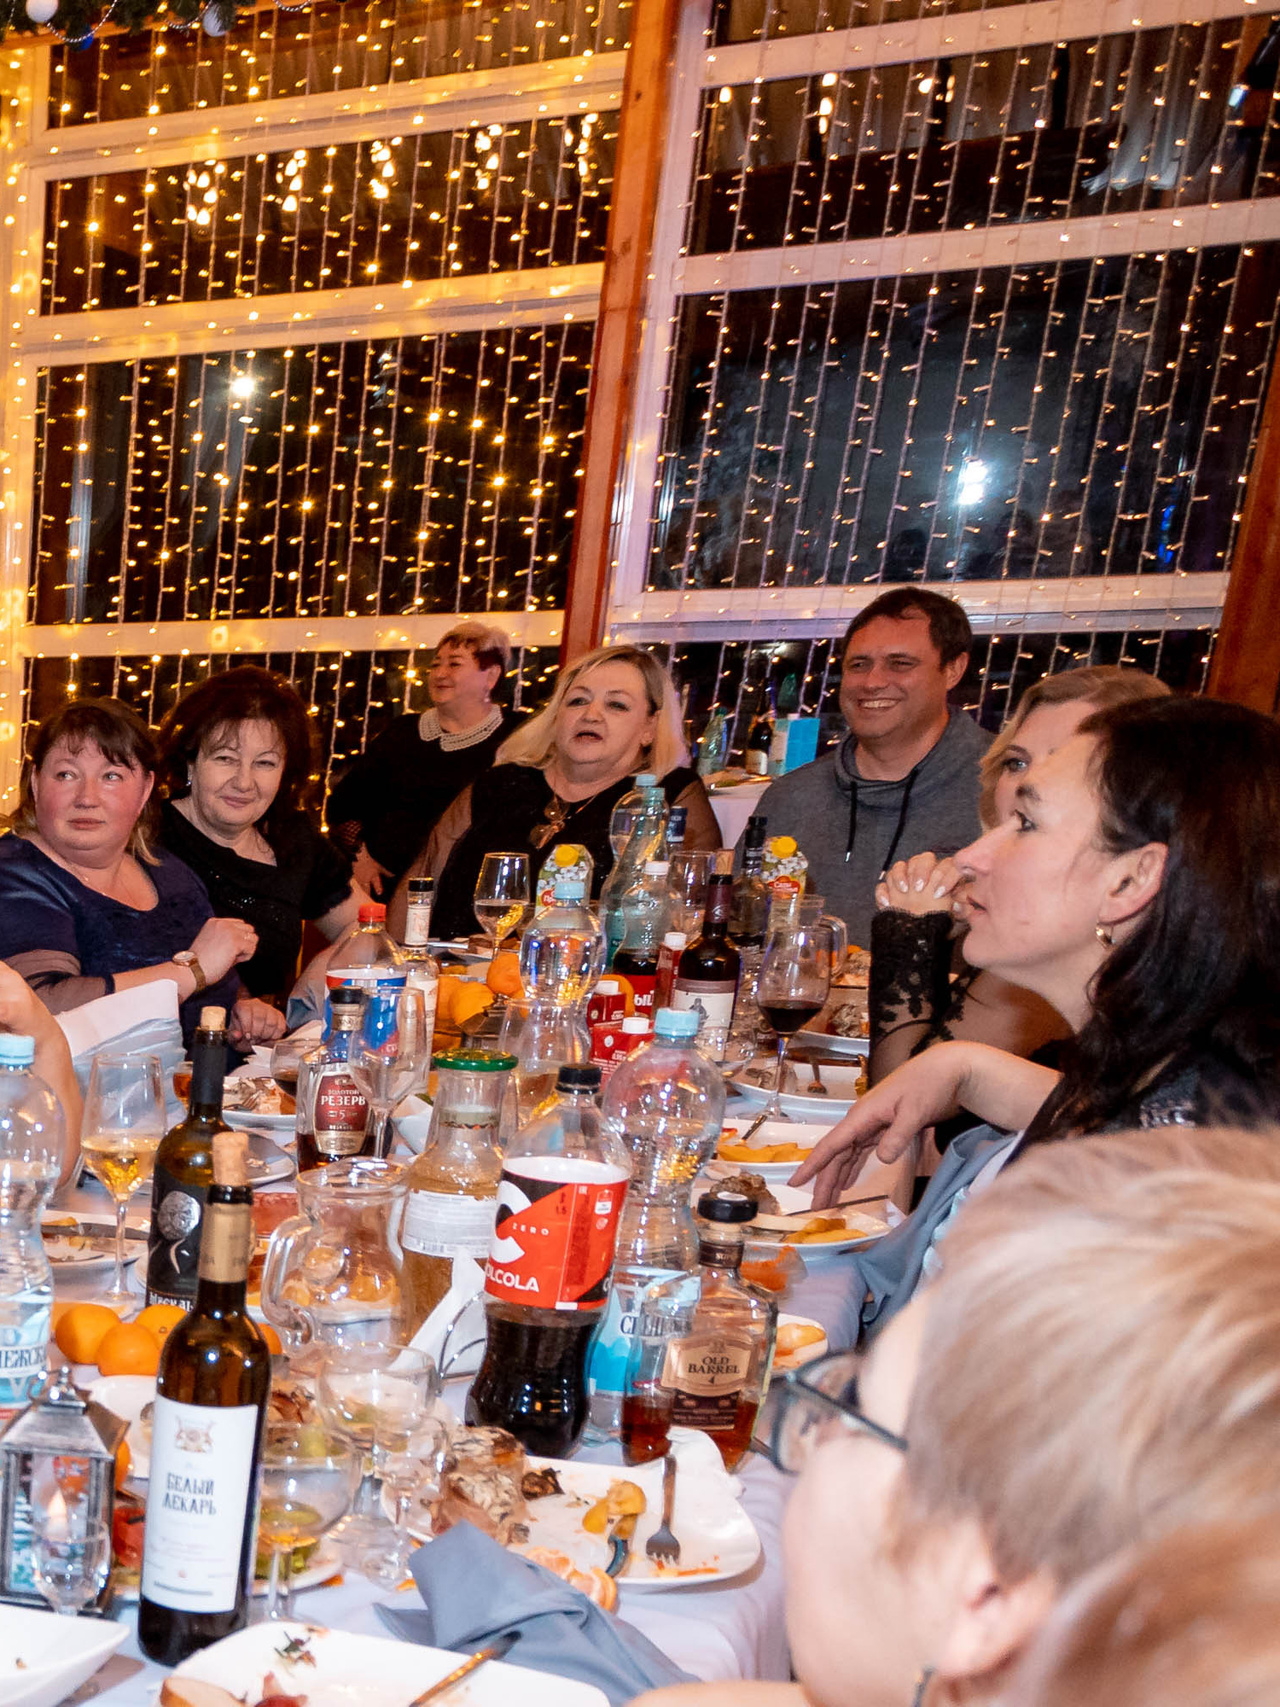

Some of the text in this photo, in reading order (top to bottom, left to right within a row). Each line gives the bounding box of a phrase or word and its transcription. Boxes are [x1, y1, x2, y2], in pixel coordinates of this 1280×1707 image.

[320, 1095, 366, 1107] РЕЗЕРВ
[512, 1222, 550, 1236] ZERO
[702, 1356, 730, 1365] OLD
[687, 1363, 740, 1374] BARREL
[166, 1472, 215, 1496] БЕЛЫЙ
[162, 1492, 217, 1515] ЛЕКАРЬ
